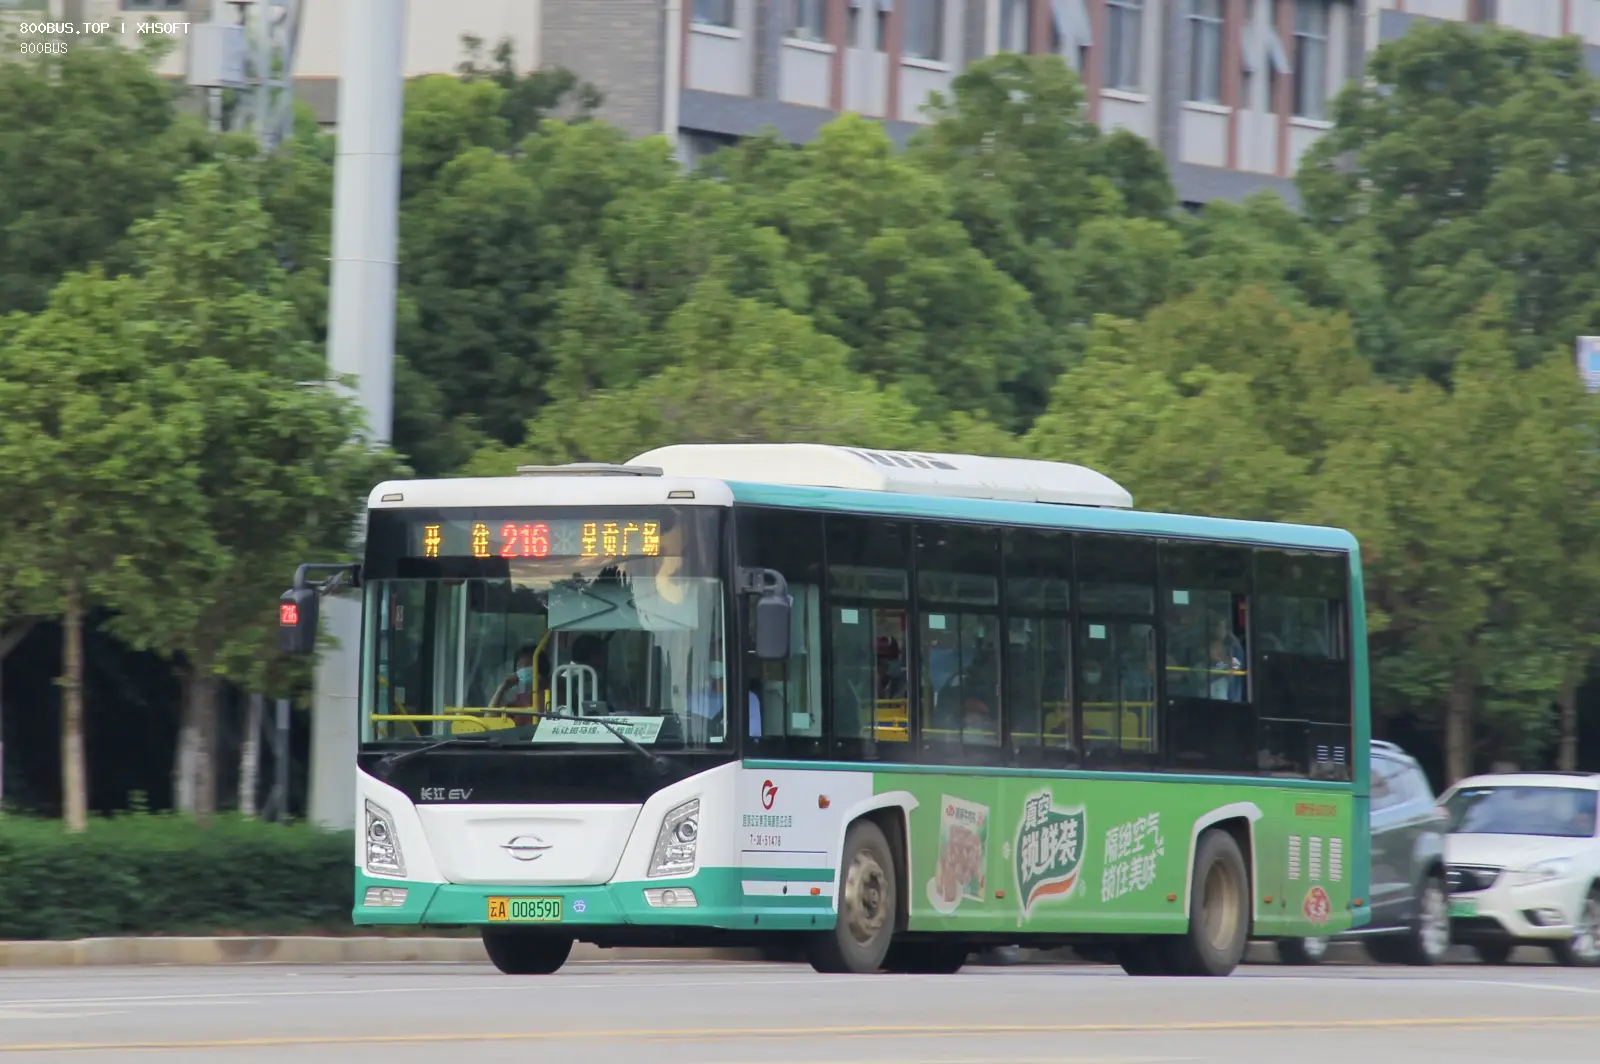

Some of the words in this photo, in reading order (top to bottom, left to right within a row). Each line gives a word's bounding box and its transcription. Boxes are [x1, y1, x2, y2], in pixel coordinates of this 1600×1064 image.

[501, 522, 549, 558] 216
[581, 522, 660, 557] 呈贡广场
[421, 787, 445, 800] 长江
[448, 788, 473, 800] EV
[1025, 793, 1050, 831] 真空
[1021, 818, 1078, 884] 锁鲜装
[1104, 812, 1165, 865] 隔绝空气
[1101, 850, 1157, 902] 锁住美味
[490, 900, 507, 918] 云A
[512, 900, 561, 918] 00859D
